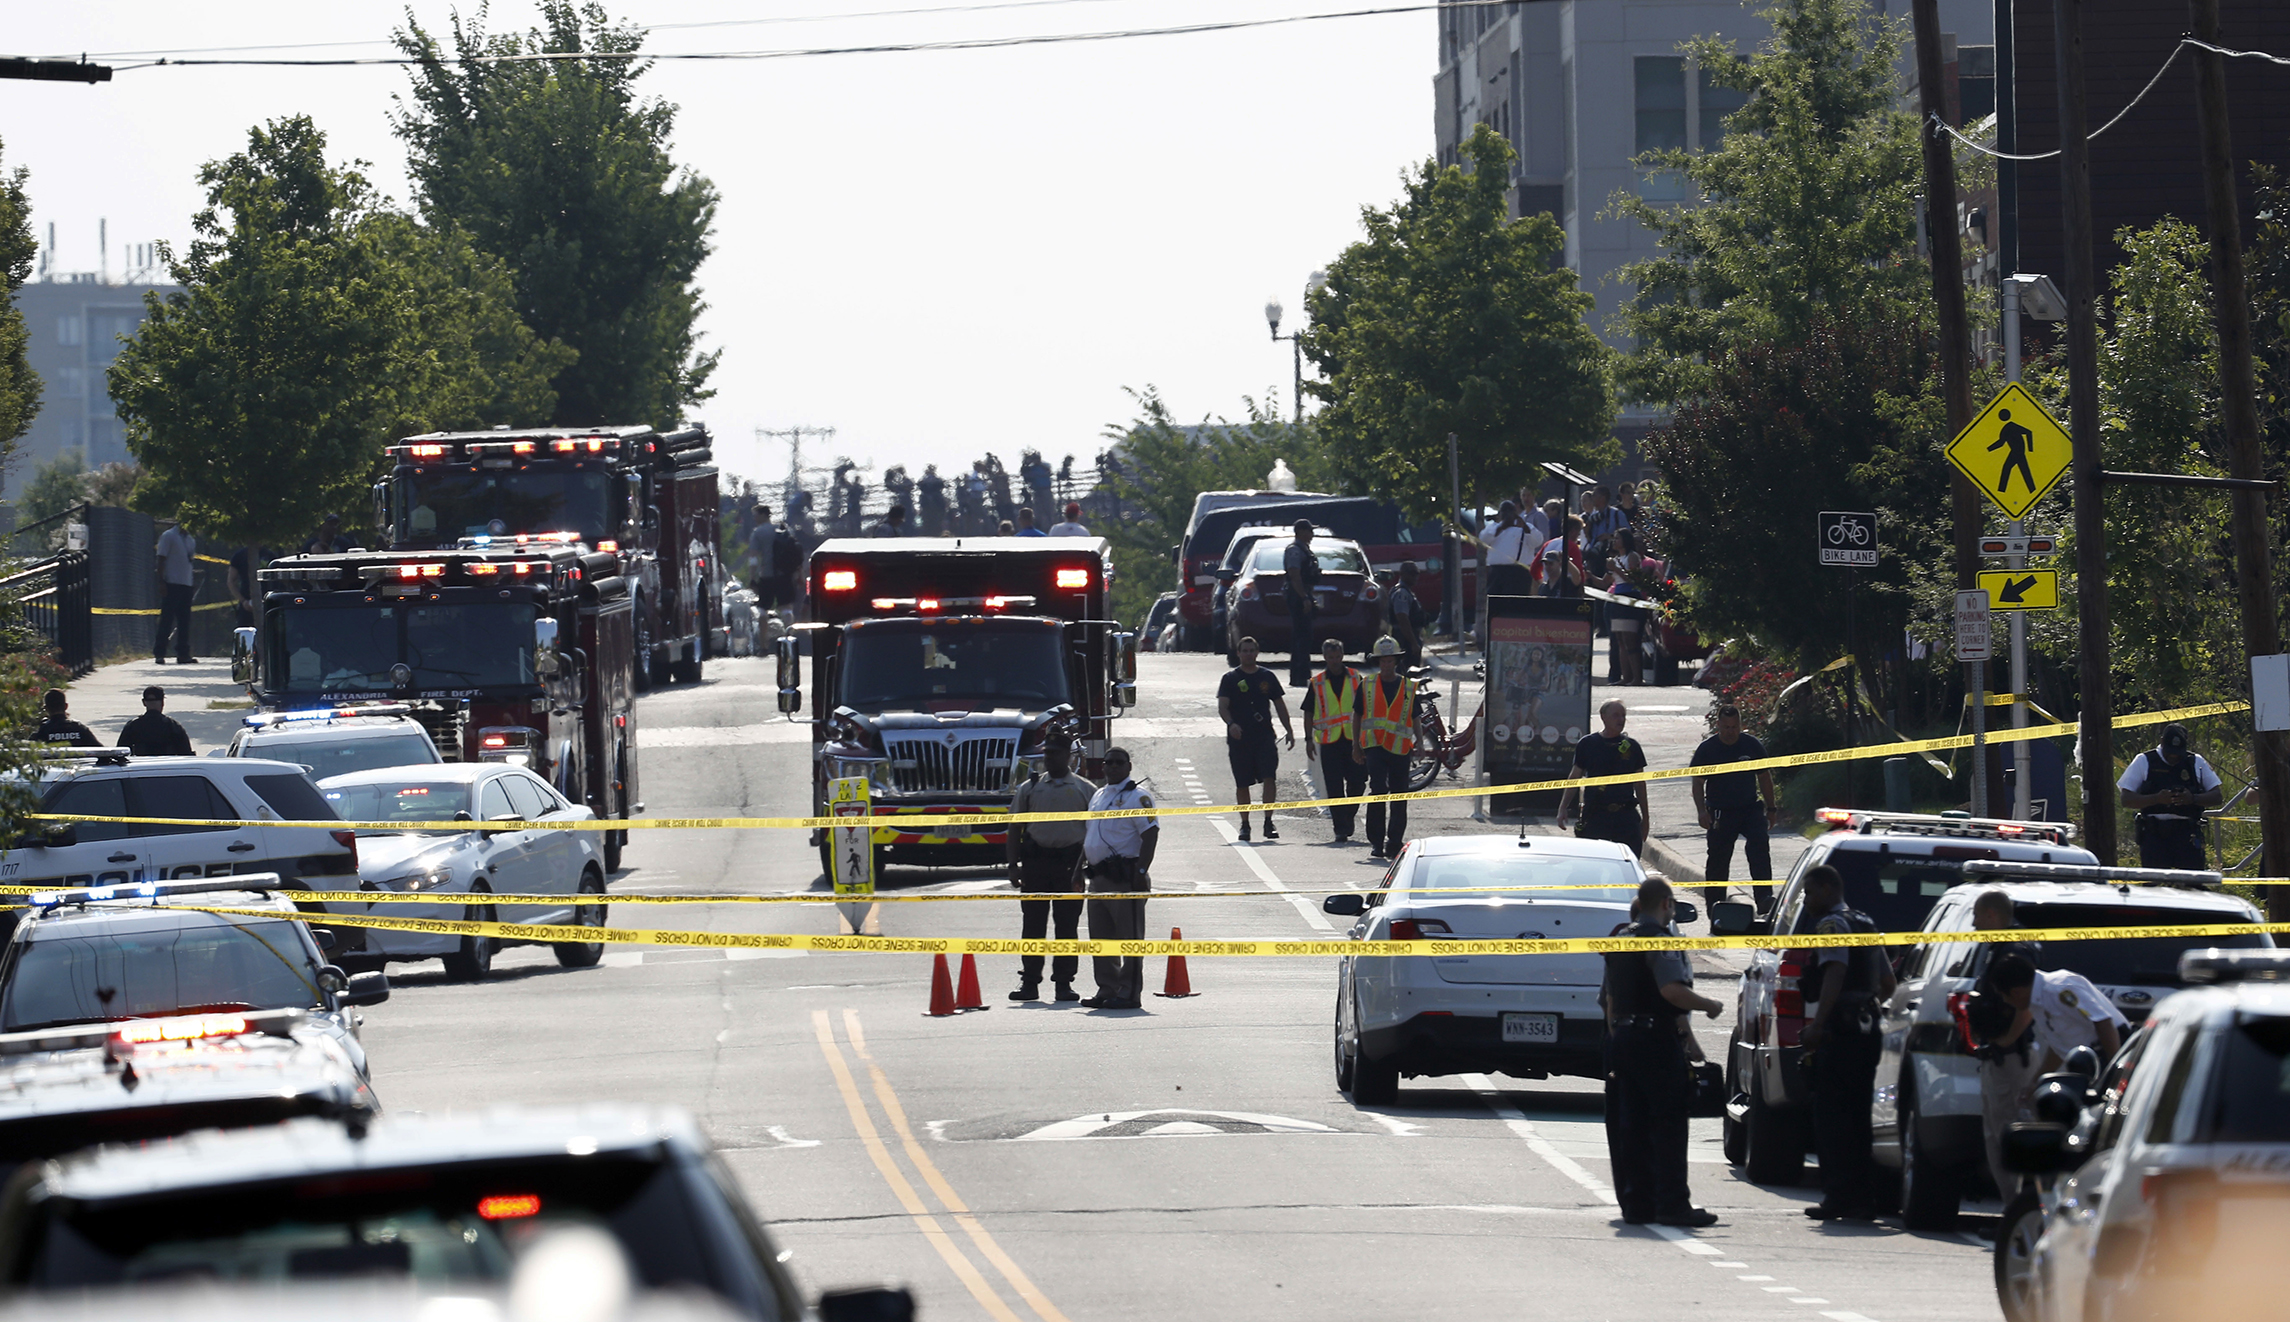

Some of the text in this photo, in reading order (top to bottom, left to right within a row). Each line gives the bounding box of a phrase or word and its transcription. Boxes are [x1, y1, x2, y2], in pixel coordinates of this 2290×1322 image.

[1825, 550, 1874, 561] BIKE LANE
[1967, 598, 1977, 609] NO
[1959, 611, 1986, 622] PARKING
[1493, 626, 1587, 639] capital bikeshare
[1960, 624, 1986, 633] HERE TO
[1961, 635, 1984, 645] CORNER
[49, 732, 81, 740] POLICE
[2, 863, 20, 876] 1717
[1506, 1022, 1553, 1036] WNN-3543
